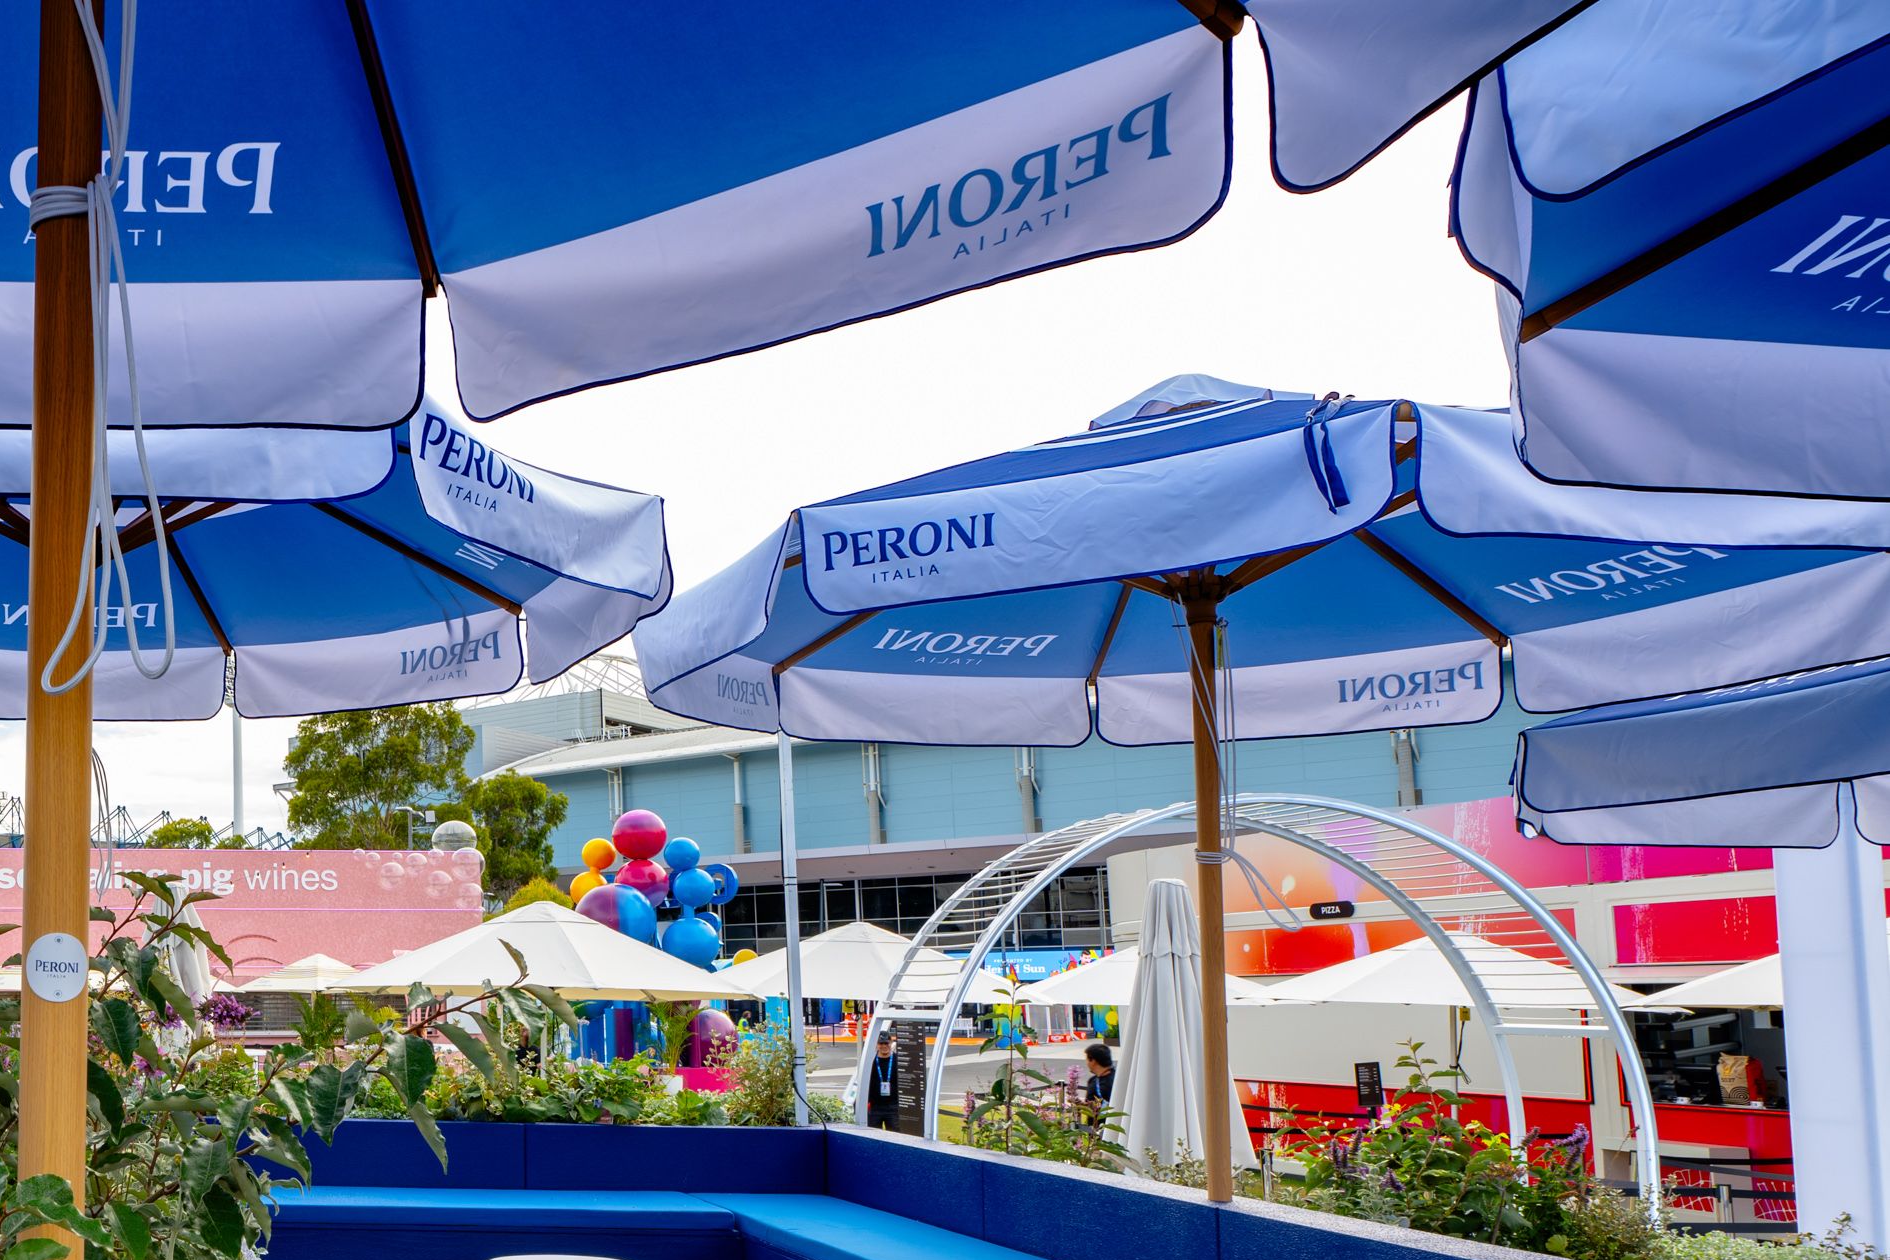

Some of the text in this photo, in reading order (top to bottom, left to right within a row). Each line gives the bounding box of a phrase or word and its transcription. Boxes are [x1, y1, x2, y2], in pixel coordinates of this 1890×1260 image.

[419, 413, 534, 503] PERONI
[447, 484, 497, 512] ITALIA
[823, 513, 996, 571] PERONI
[872, 565, 940, 582] ITALIA
[181, 862, 235, 896] pig
[244, 862, 339, 891] wines
[1321, 906, 1341, 914] PIZZA
[35, 959, 79, 973] PERONI
[1023, 963, 1047, 974] Sun
